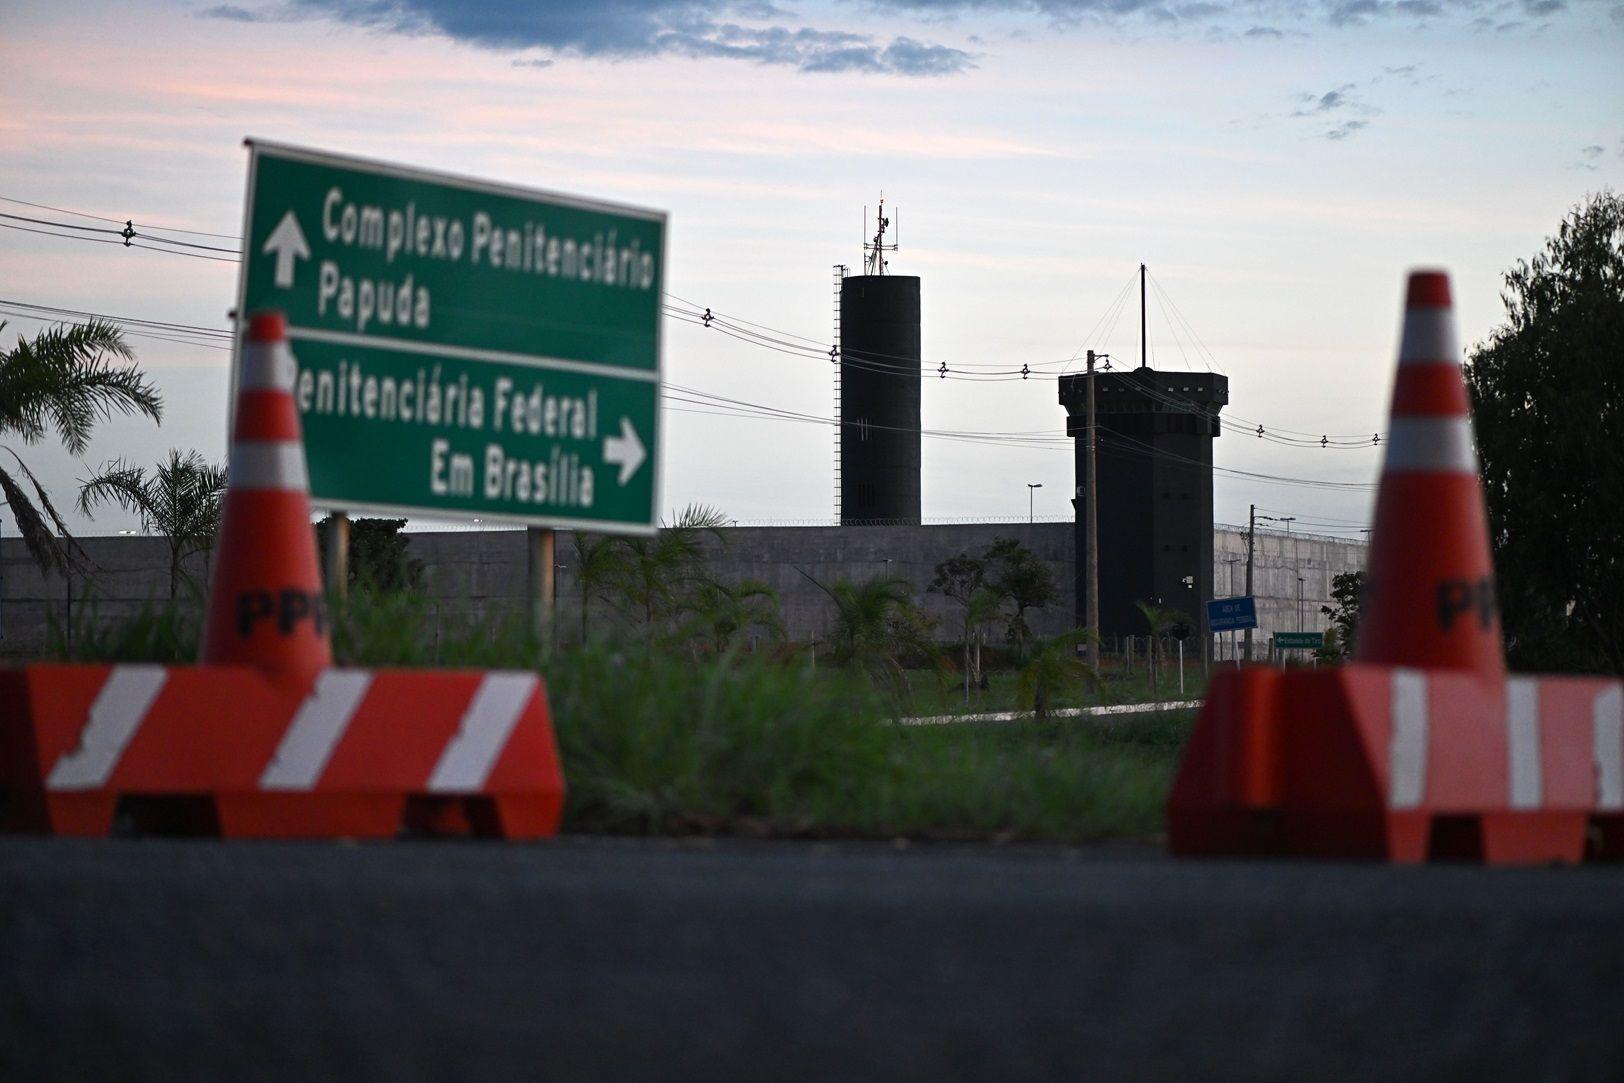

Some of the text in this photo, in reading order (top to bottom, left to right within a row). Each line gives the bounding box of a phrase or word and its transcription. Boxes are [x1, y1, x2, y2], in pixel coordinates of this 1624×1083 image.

[322, 186, 654, 290] Complexo Penitenciário
[318, 260, 430, 332] Papuda
[296, 359, 598, 440] enitenciária Federal
[430, 438, 595, 507] Em Brasília
